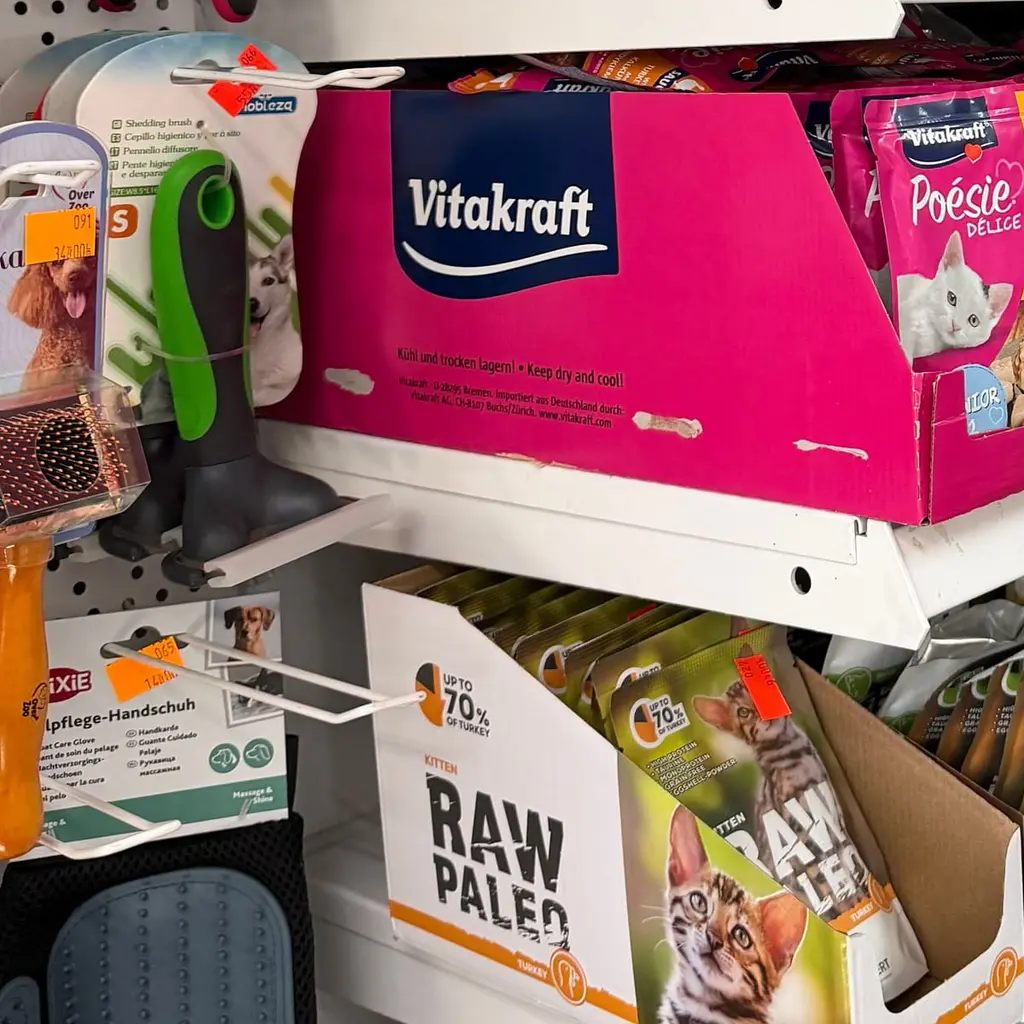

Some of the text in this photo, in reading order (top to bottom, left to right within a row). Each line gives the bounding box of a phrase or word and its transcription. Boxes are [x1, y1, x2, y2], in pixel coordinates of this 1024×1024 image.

[125, 118, 192, 130] Shedding brush
[124, 131, 195, 142] Cepillo higienico
[902, 121, 989, 149] Vitakraft
[123, 146, 160, 156] Pennello
[122, 161, 147, 170] Pente
[68, 189, 95, 202] Over
[910, 175, 1013, 226] Poésie
[408, 177, 594, 238] Vitakraft
[74, 214, 91, 230] 091
[111, 209, 129, 234] S
[966, 212, 1022, 239] DÉLICE
[397, 347, 625, 389] Kühl und trocken lagern! Keep dry and cool!
[495, 389, 534, 404] Importiert
[535, 394, 549, 405] aus
[550, 395, 598, 413] Deutschland
[538, 407, 613, 429] www.vitakraft.com
[443, 673, 473, 691] UP TO
[444, 689, 490, 728] 70%
[649, 697, 669, 712] UP TO
[447, 715, 491, 738] OF TURKEY
[652, 706, 684, 728] 70%
[658, 718, 686, 735] OF TURKEY
[54, 737, 95, 749] Care Glove
[139, 731, 197, 747] Guante Cuidado
[54, 743, 120, 759] de soin du pelage
[668, 741, 697, 760] PROTEIN
[424, 752, 458, 776] KITTEN
[656, 757, 685, 774] TAURINE
[660, 753, 710, 783] MONOPROTEIN
[89, 776, 105, 785] cura
[664, 764, 706, 790] GRAIN FREE
[52, 792, 67, 804] pelo
[426, 772, 564, 893] RAW
[433, 853, 571, 952] PALEO
[517, 958, 549, 979] TURKEY
[963, 988, 990, 1014] TURKEY
